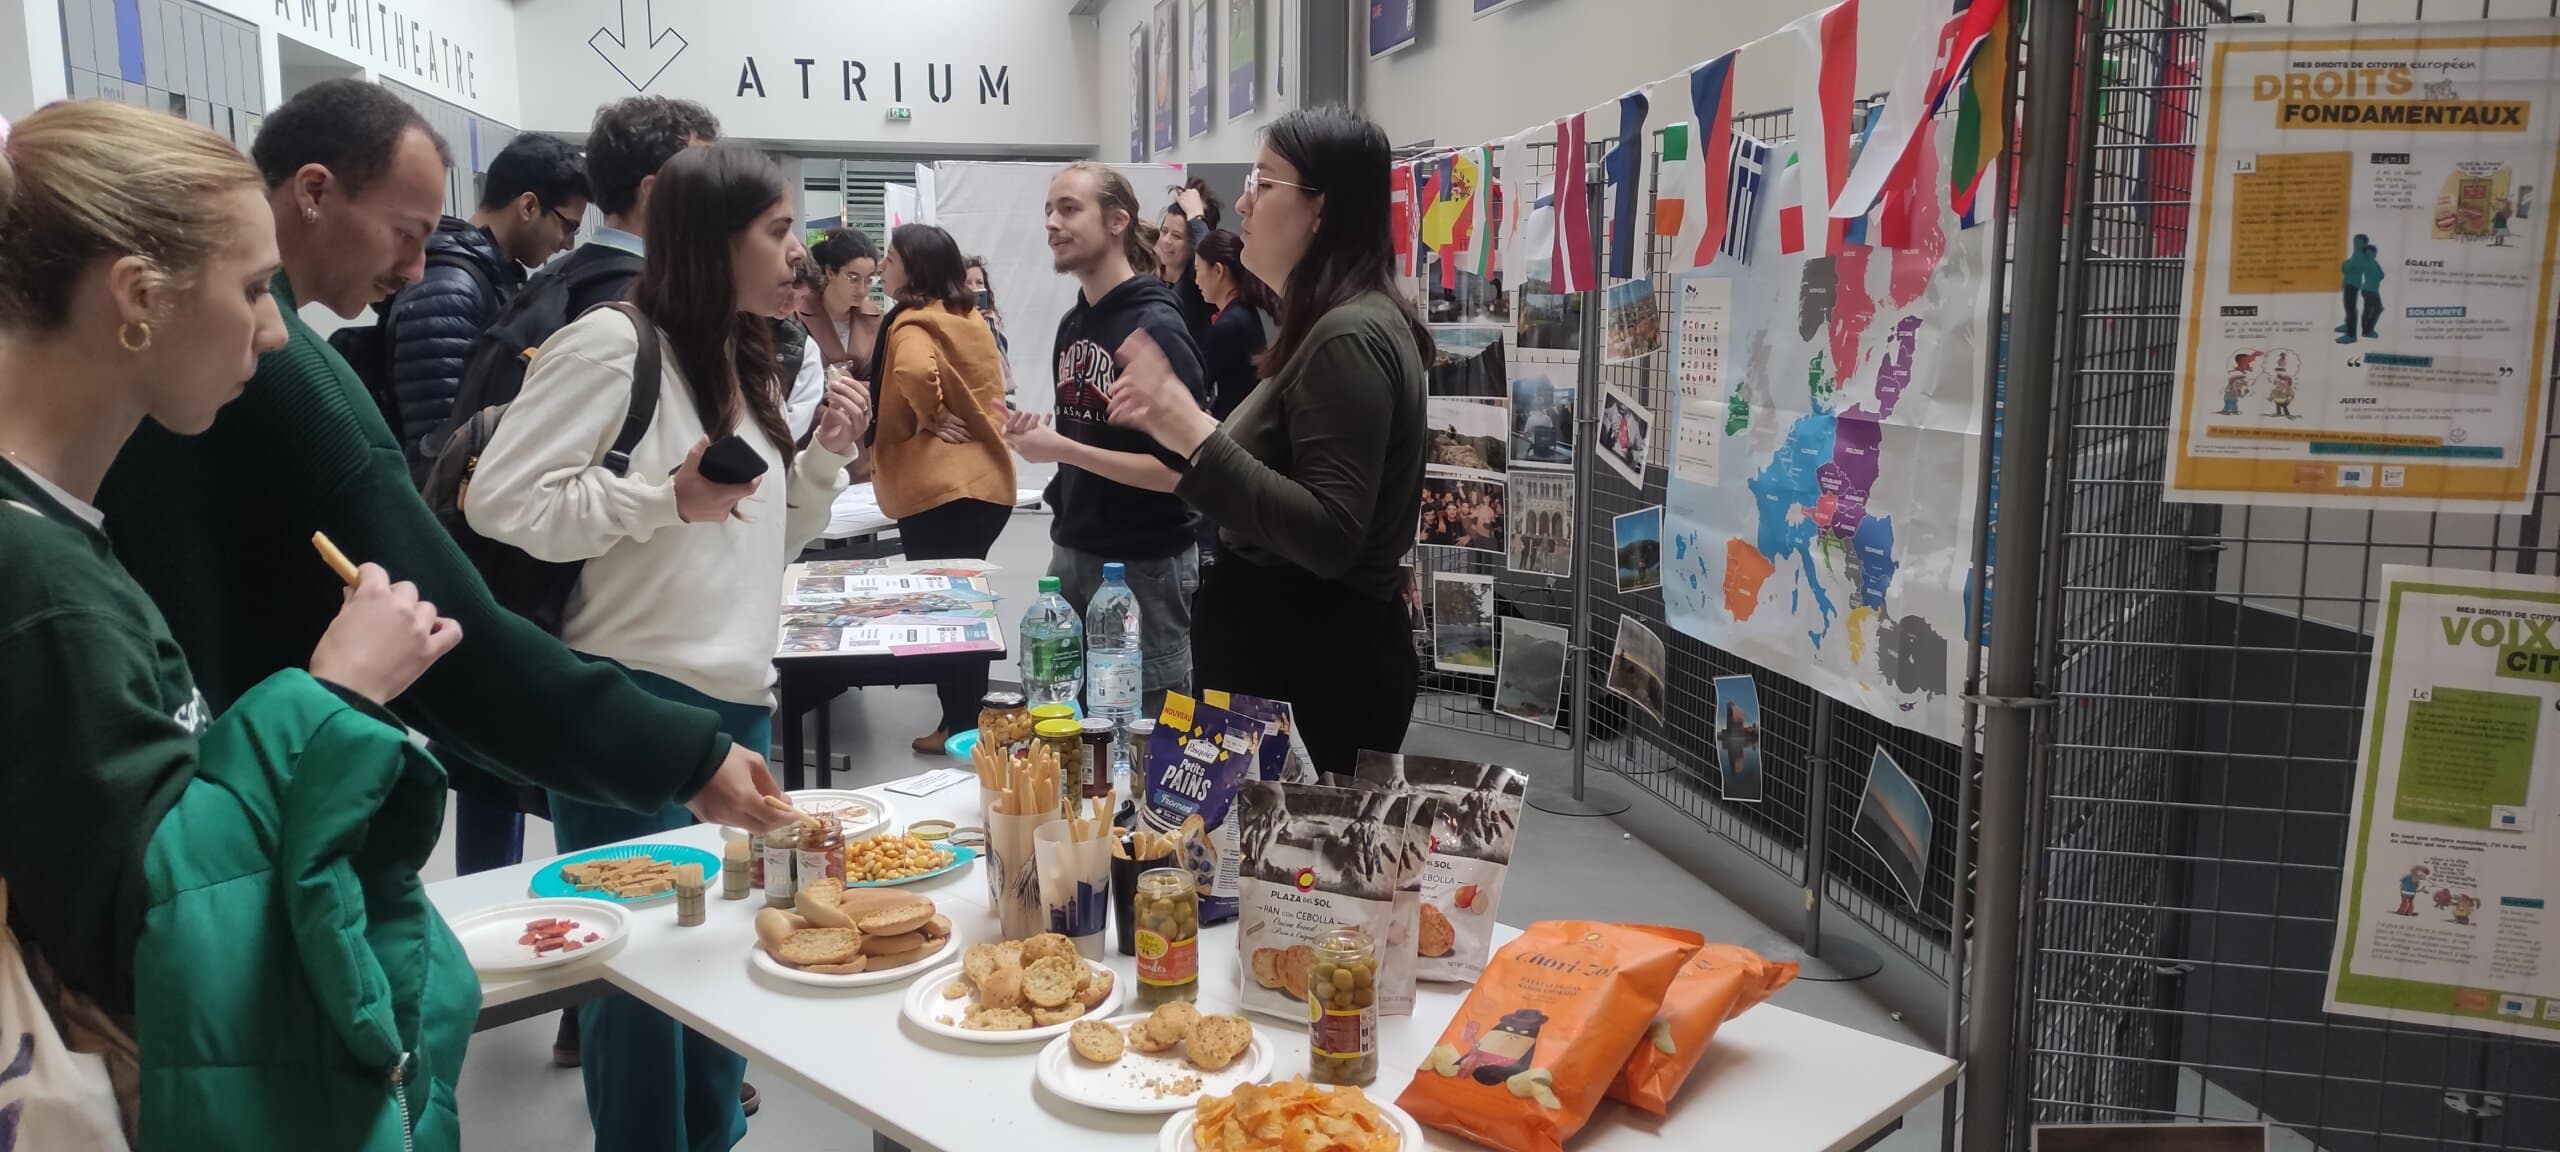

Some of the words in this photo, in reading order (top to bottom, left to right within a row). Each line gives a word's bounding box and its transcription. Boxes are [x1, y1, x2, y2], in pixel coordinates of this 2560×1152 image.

[2293, 61, 2312, 69] MES
[2314, 61, 2349, 69] DROITS
[2350, 61, 2363, 69] DE
[2366, 61, 2407, 69] CITOYEN
[2410, 56, 2475, 74] européen
[736, 56, 1010, 105] ATRIUM
[2253, 68, 2414, 101] DROITS
[2284, 103, 2521, 126] FONDAMENTAUX
[2339, 397, 2377, 405] JUSTICE
[2456, 606, 2476, 614] MES
[2479, 607, 2513, 618] DROITS
[2515, 611, 2528, 619] DE
[2441, 616, 2557, 650] VOIX
[2506, 651, 2560, 675] CIT
[1164, 707, 1192, 722] NOUVEAU
[1180, 758, 1206, 777] Petits
[1160, 764, 1212, 802] PAINS
[1434, 861, 1452, 870] SOL
[1422, 873, 1455, 884] EBOLLA
[1270, 890, 1302, 904] PLAZA
[1302, 897, 1314, 905] DEL
[1313, 898, 1332, 909] SOL
[1263, 904, 1280, 915] PAN
[1296, 911, 1335, 926] CEBOLLA
[1295, 921, 1319, 932] bread
